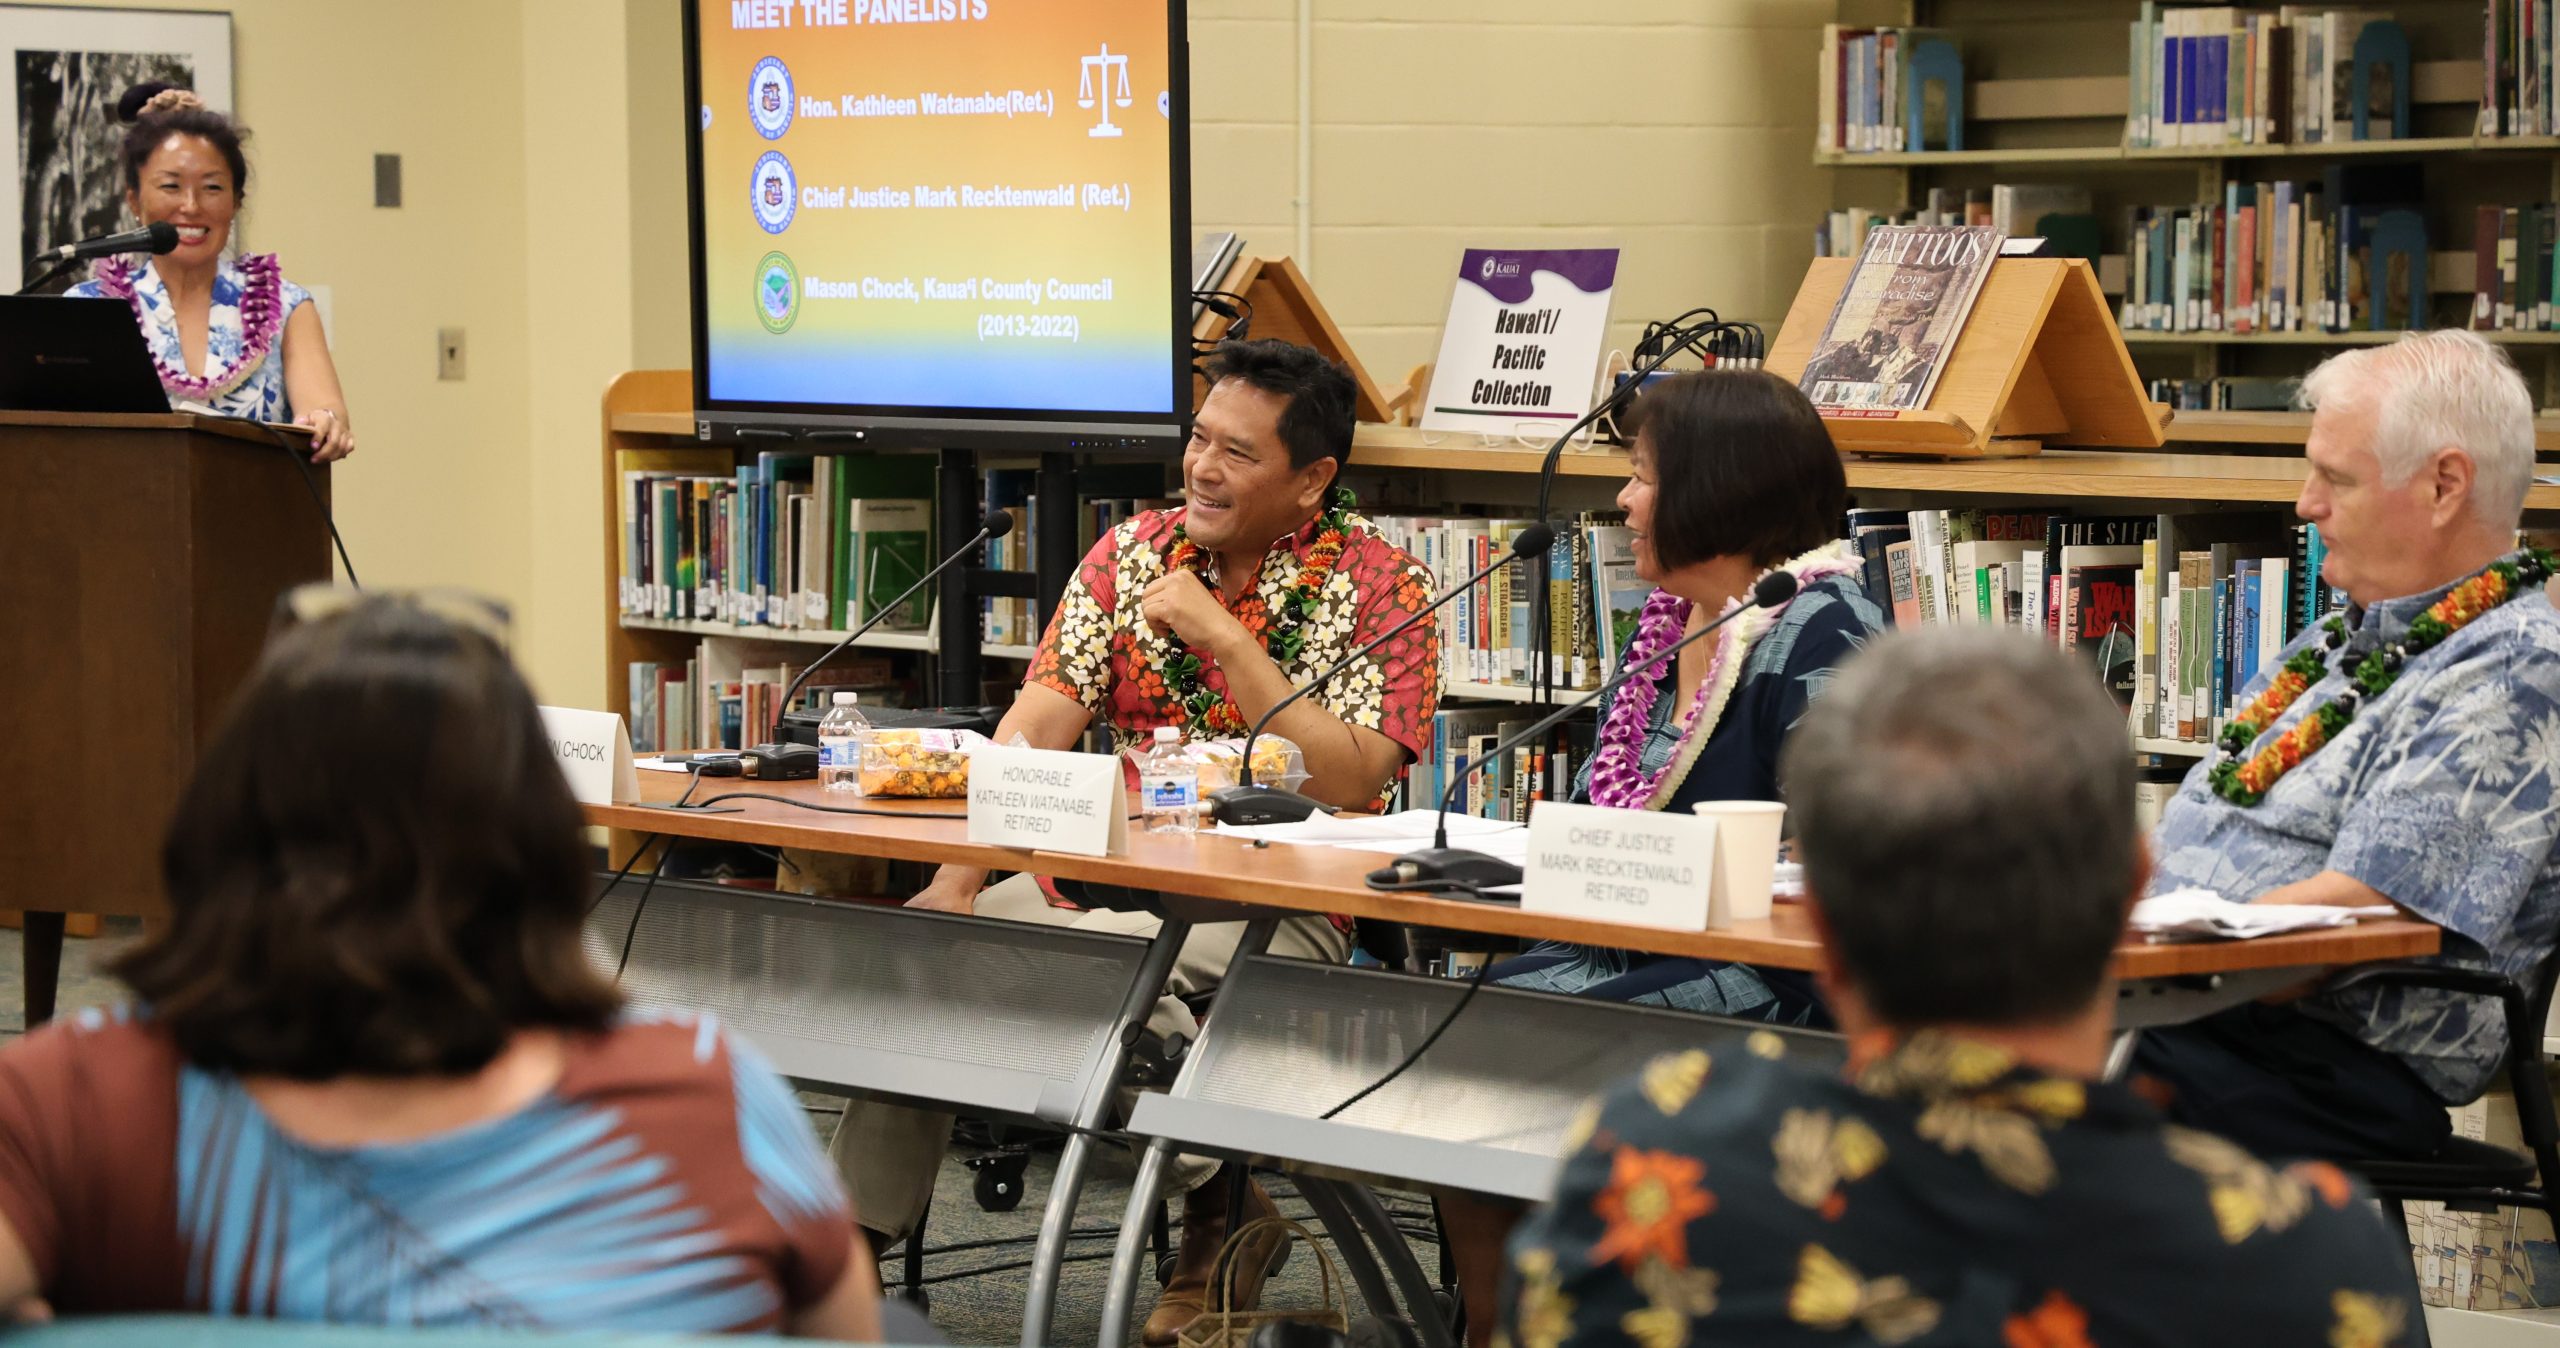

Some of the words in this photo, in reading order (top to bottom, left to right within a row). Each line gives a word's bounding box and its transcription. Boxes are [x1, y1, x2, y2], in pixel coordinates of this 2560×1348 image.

[731, 0, 794, 29] MEET
[801, 0, 848, 26] THE
[855, 0, 988, 24] PANELISTS
[800, 96, 838, 118] Hon.
[842, 94, 917, 117] Kathleen
[802, 186, 846, 208] Chief
[848, 186, 911, 208] Justice
[914, 185, 958, 208] Mark
[961, 184, 1076, 207] Recktenwald
[1081, 182, 1131, 213] (Ret.)
[1864, 230, 1990, 267] TATTOOS
[804, 276, 859, 299] Mason
[861, 276, 920, 304] Chock,
[981, 277, 1042, 305] County
[1046, 277, 1113, 300] Council
[977, 313, 1080, 343] (2013-2022)
[1492, 344, 1547, 370] Pacific
[1471, 378, 1552, 407] Collection
[1560, 530, 1568, 554] IAN
[2060, 523, 2095, 545] THE
[2106, 521, 2157, 545] SIEG
[1551, 533, 1559, 568] TOLL
[1572, 534, 1581, 563] WAR
[1943, 542, 1952, 574] HARBOR
[1572, 564, 1581, 579] IN
[2304, 563, 2313, 598] PACIFIC
[1458, 595, 1467, 617] AND
[1572, 579, 1581, 609] THE
[2028, 590, 2036, 610] The
[2068, 587, 2080, 625] WAKE
[2217, 594, 2225, 609] The
[1499, 582, 1508, 639] STRAGGLERS
[1560, 592, 1568, 640] PACIFIC
[2217, 610, 2225, 633] South
[1458, 619, 1467, 644] WAR
[1572, 610, 1581, 656] PACIFIC
[2216, 634, 2224, 659] Pacific
[563, 741, 605, 761] CHOCK
[1002, 766, 1073, 788] HONORABLE
[975, 788, 1026, 808] KATHLEEN
[1029, 793, 1096, 818] WATANABE,
[1004, 813, 1053, 834] RETIRED
[1568, 826, 1613, 848] CHIEF
[1615, 831, 1676, 855] JUSTICE
[1539, 852, 1582, 873] MARK
[1584, 881, 1650, 906] RETIRED
